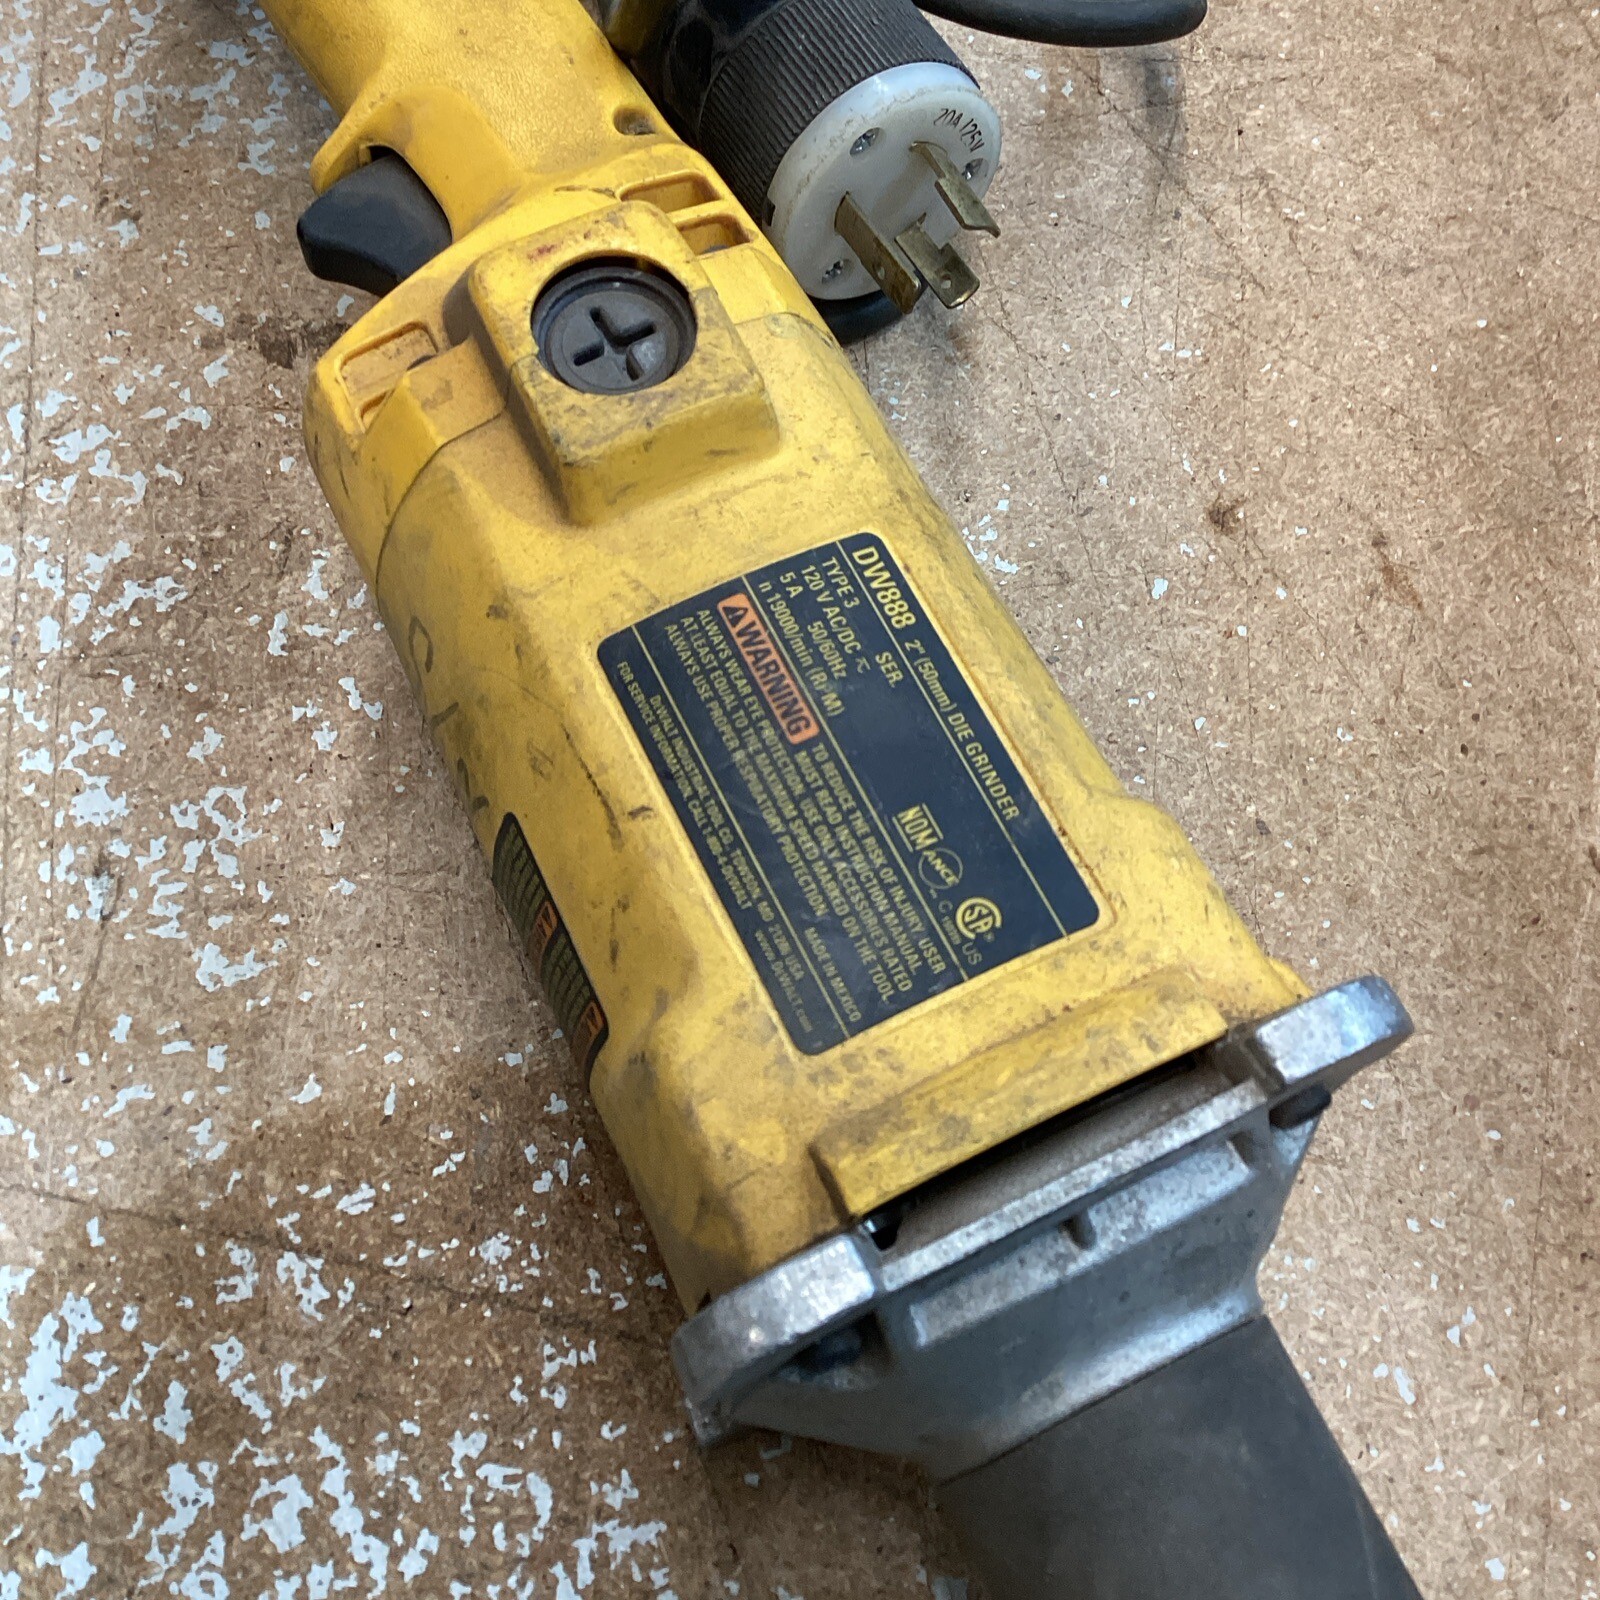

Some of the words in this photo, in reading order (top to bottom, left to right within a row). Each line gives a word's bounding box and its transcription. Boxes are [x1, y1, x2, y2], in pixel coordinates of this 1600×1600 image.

[933, 107, 964, 128] 20A
[959, 118, 985, 153] 125V
[756, 580, 774, 593] n
[777, 570, 797, 585] 5
[783, 581, 806, 599] A
[798, 563, 826, 592] 120
[813, 589, 834, 605] V
[849, 543, 919, 631] DW888
[678, 614, 700, 634] AT
[694, 606, 734, 660] ALWAYS
[761, 591, 819, 669] 19000/min
[818, 555, 855, 598] TYPE
[841, 595, 861, 610] 3
[872, 649, 907, 688] SER.
[819, 602, 863, 655] AC/DC
[687, 631, 720, 671] LEAST
[803, 619, 852, 681] 50/60Hz
[902, 637, 926, 658] 2"
[614, 659, 636, 683] FOR
[706, 668, 741, 712] EQUAL
[721, 657, 754, 697] WEAR
[730, 619, 815, 737] WARNING
[911, 654, 959, 714] (50mm)
[624, 679, 658, 726] SERVICE
[728, 708, 751, 730] TO
[742, 694, 766, 720] EYE
[662, 622, 702, 676] ALWAYS
[689, 673, 715, 703] USE
[702, 698, 742, 751] PROPER
[728, 748, 787, 836] RESPIRATORY
[737, 726, 763, 754] THE
[945, 710, 976, 743] DIE
[668, 735, 713, 800] INDUSTRIAL
[808, 741, 831, 763] TO
[751, 751, 800, 821] MAXIMUM
[818, 759, 859, 812] REDUCE
[961, 739, 1022, 821] GRINDER
[684, 797, 710, 828] CALL
[792, 748, 825, 790] MUST
[812, 786, 845, 826] READ
[831, 822, 893, 913] INSTRUCTION
[796, 796, 824, 827] USE
[845, 808, 872, 837] THE
[786, 816, 822, 862] SPEED
[809, 822, 844, 862] ONLY
[859, 834, 890, 869] RISK
[894, 804, 940, 852] NOM
[921, 849, 959, 888] ANCE
[808, 858, 852, 918] MARKED
[876, 864, 899, 887] OF
[829, 858, 891, 949] ACCESSORIES
[801, 925, 832, 963] MADE
[838, 913, 863, 939] ON
[820, 960, 839, 978] IN
[850, 935, 878, 966] THE
[877, 945, 914, 994] RATED
[915, 935, 948, 975] USER
[958, 940, 984, 967] US
[827, 974, 864, 1024] MEXICO
